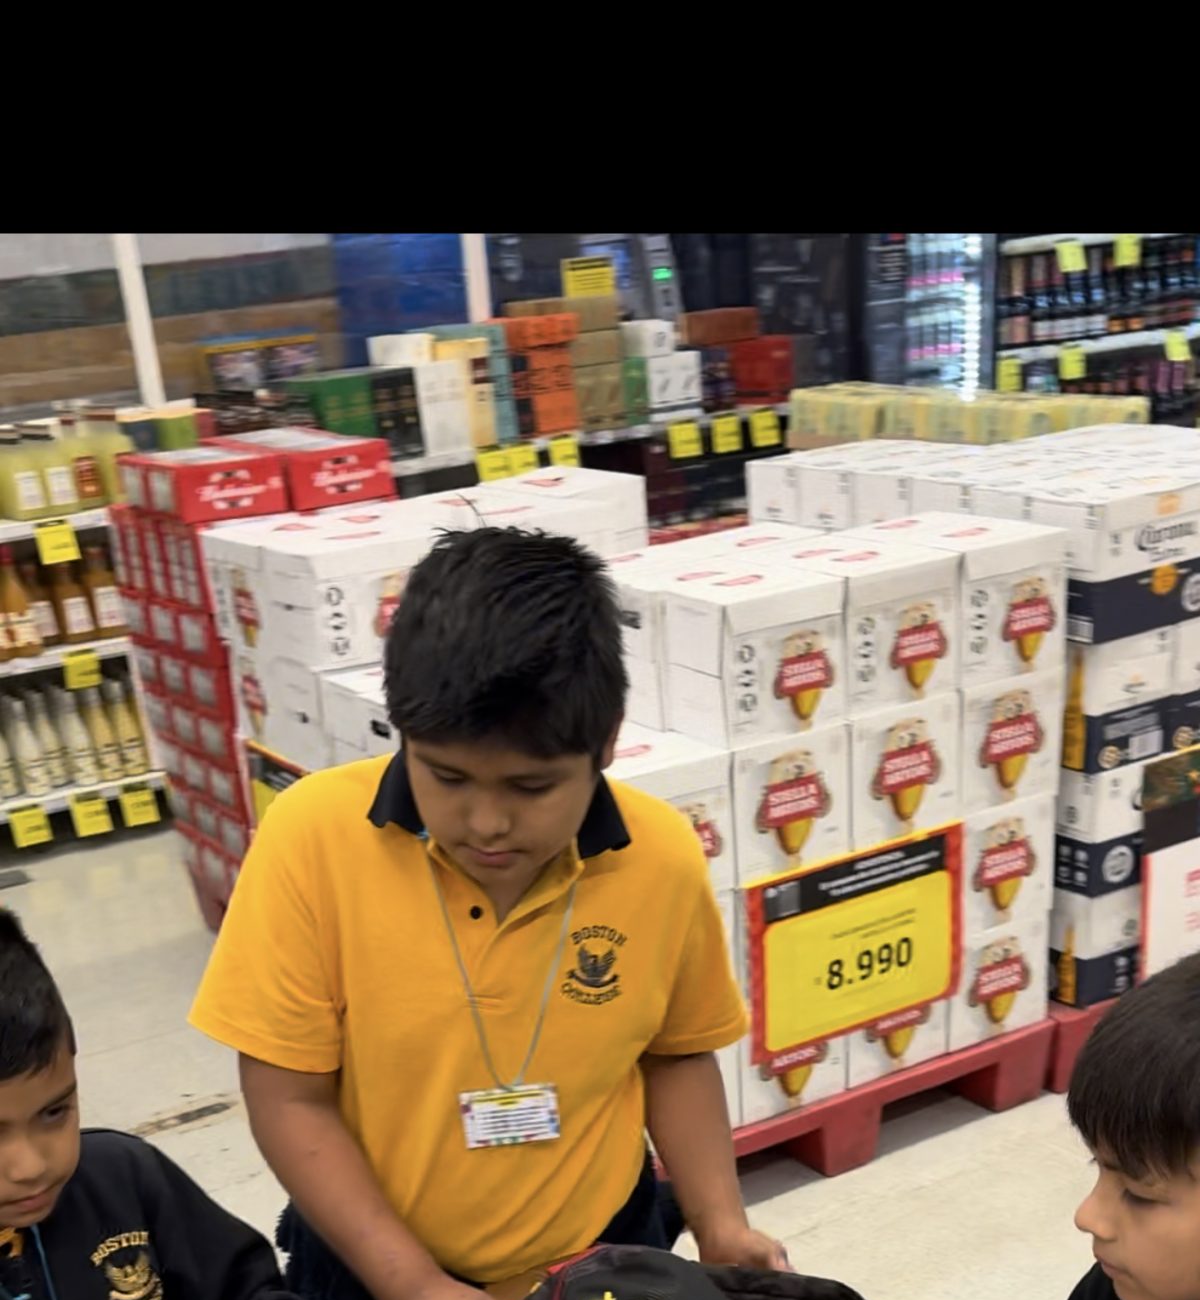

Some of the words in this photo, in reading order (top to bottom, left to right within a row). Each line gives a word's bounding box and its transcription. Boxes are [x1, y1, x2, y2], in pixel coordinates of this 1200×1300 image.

[570, 925, 628, 946] BOSTON
[826, 937, 913, 990] 8.990
[90, 1231, 149, 1266] BOSTON
